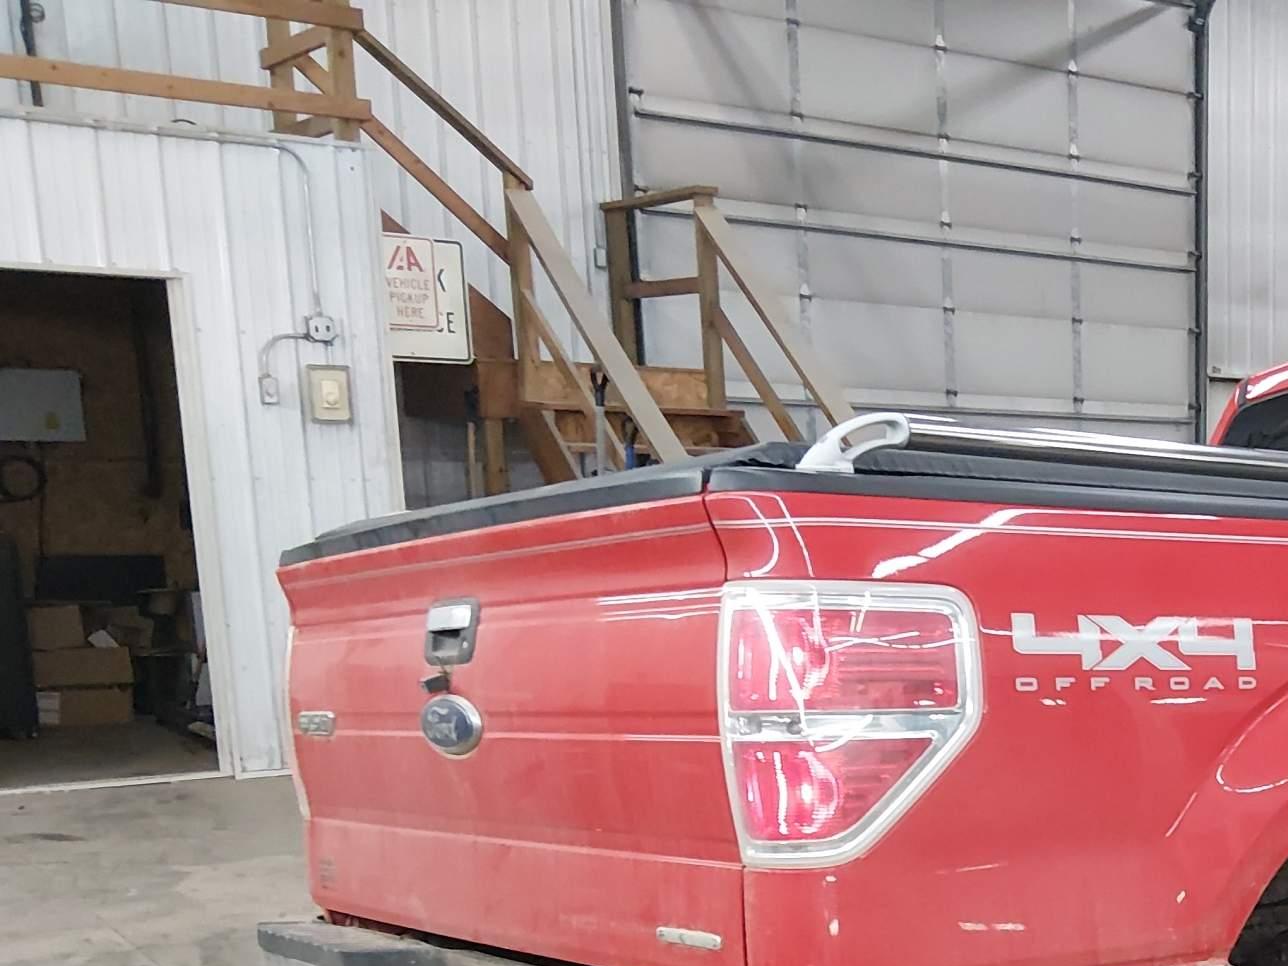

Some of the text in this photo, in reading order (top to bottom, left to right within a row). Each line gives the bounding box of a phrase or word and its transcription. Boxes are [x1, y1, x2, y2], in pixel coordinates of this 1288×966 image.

[385, 276, 430, 291] VEHICLE
[389, 291, 429, 304] PICKUP
[396, 306, 425, 319] HERE
[1015, 676, 1257, 692] OFF ROAD
